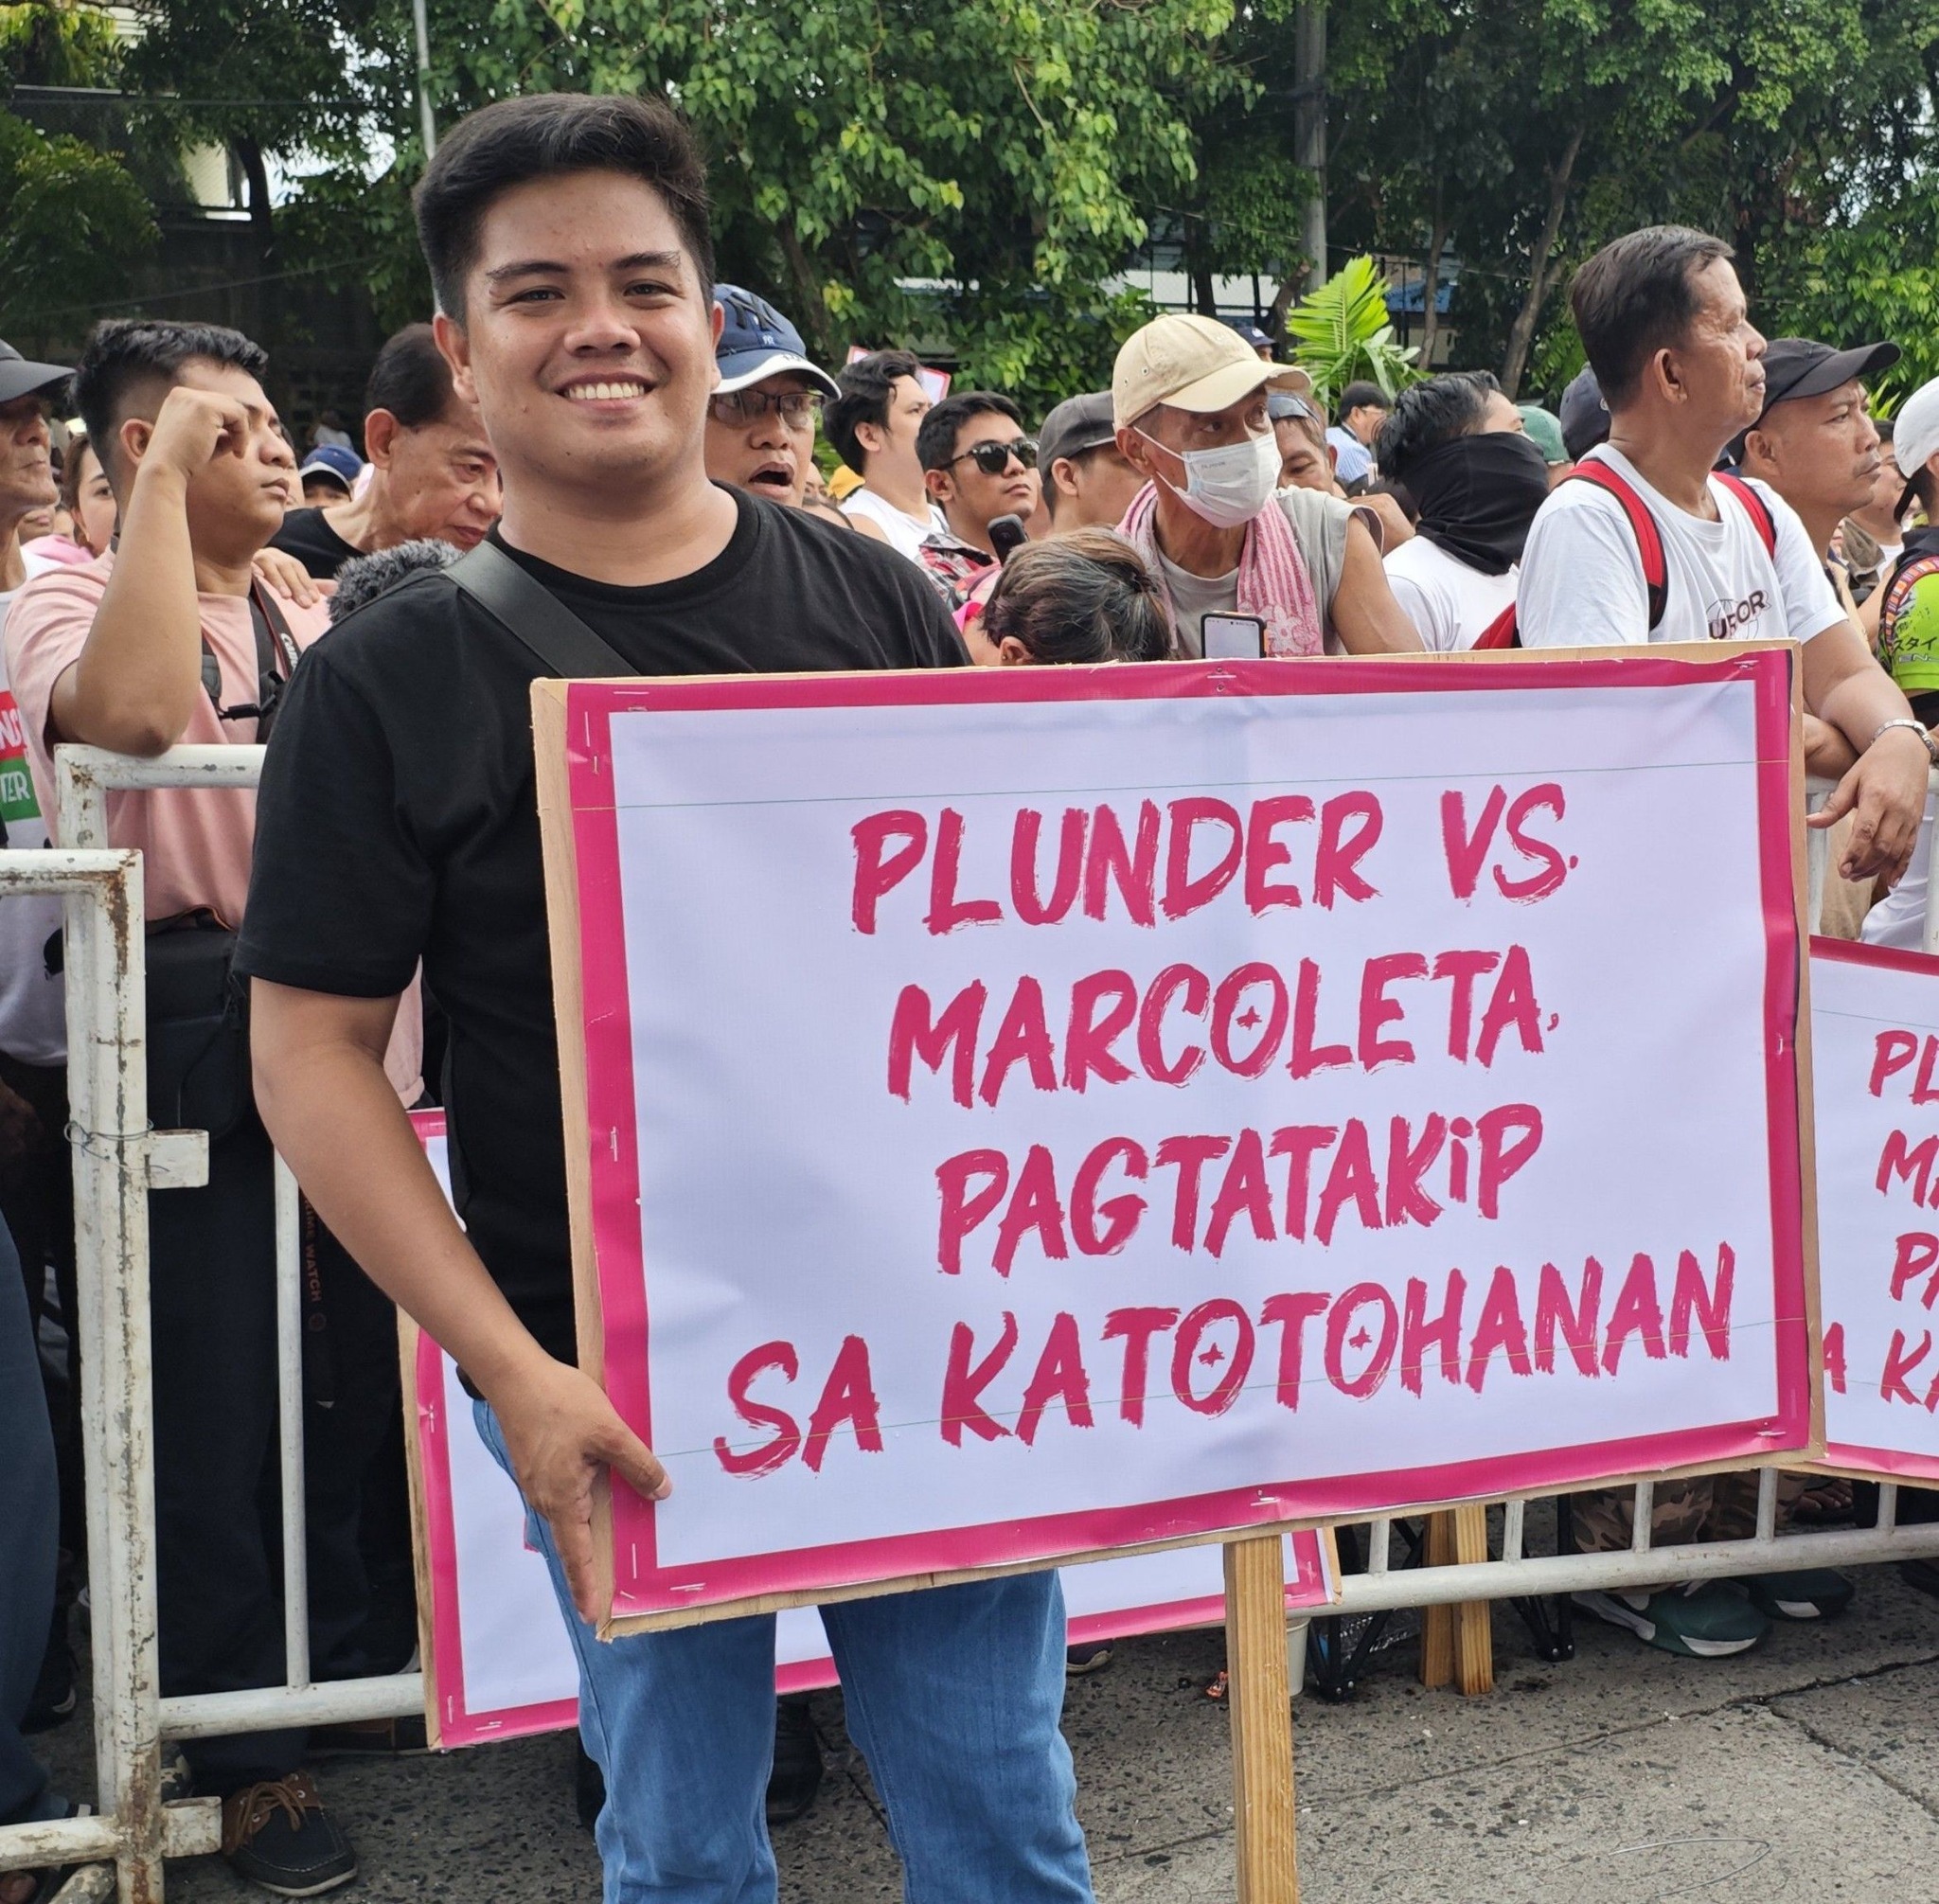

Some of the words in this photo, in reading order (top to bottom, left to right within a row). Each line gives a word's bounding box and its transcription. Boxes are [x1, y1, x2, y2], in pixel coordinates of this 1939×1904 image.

[850, 791, 1383, 935] PLUNDER
[1440, 783, 1579, 907] VS.
[1868, 1030, 1939, 1106] PL
[1876, 1129, 1939, 1209] M
[305, 1244, 322, 1302] WATCH
[714, 1334, 883, 1480] SA
[939, 1241, 1736, 1448] KATOTOHANAN
[1880, 1328, 1939, 1414] K
